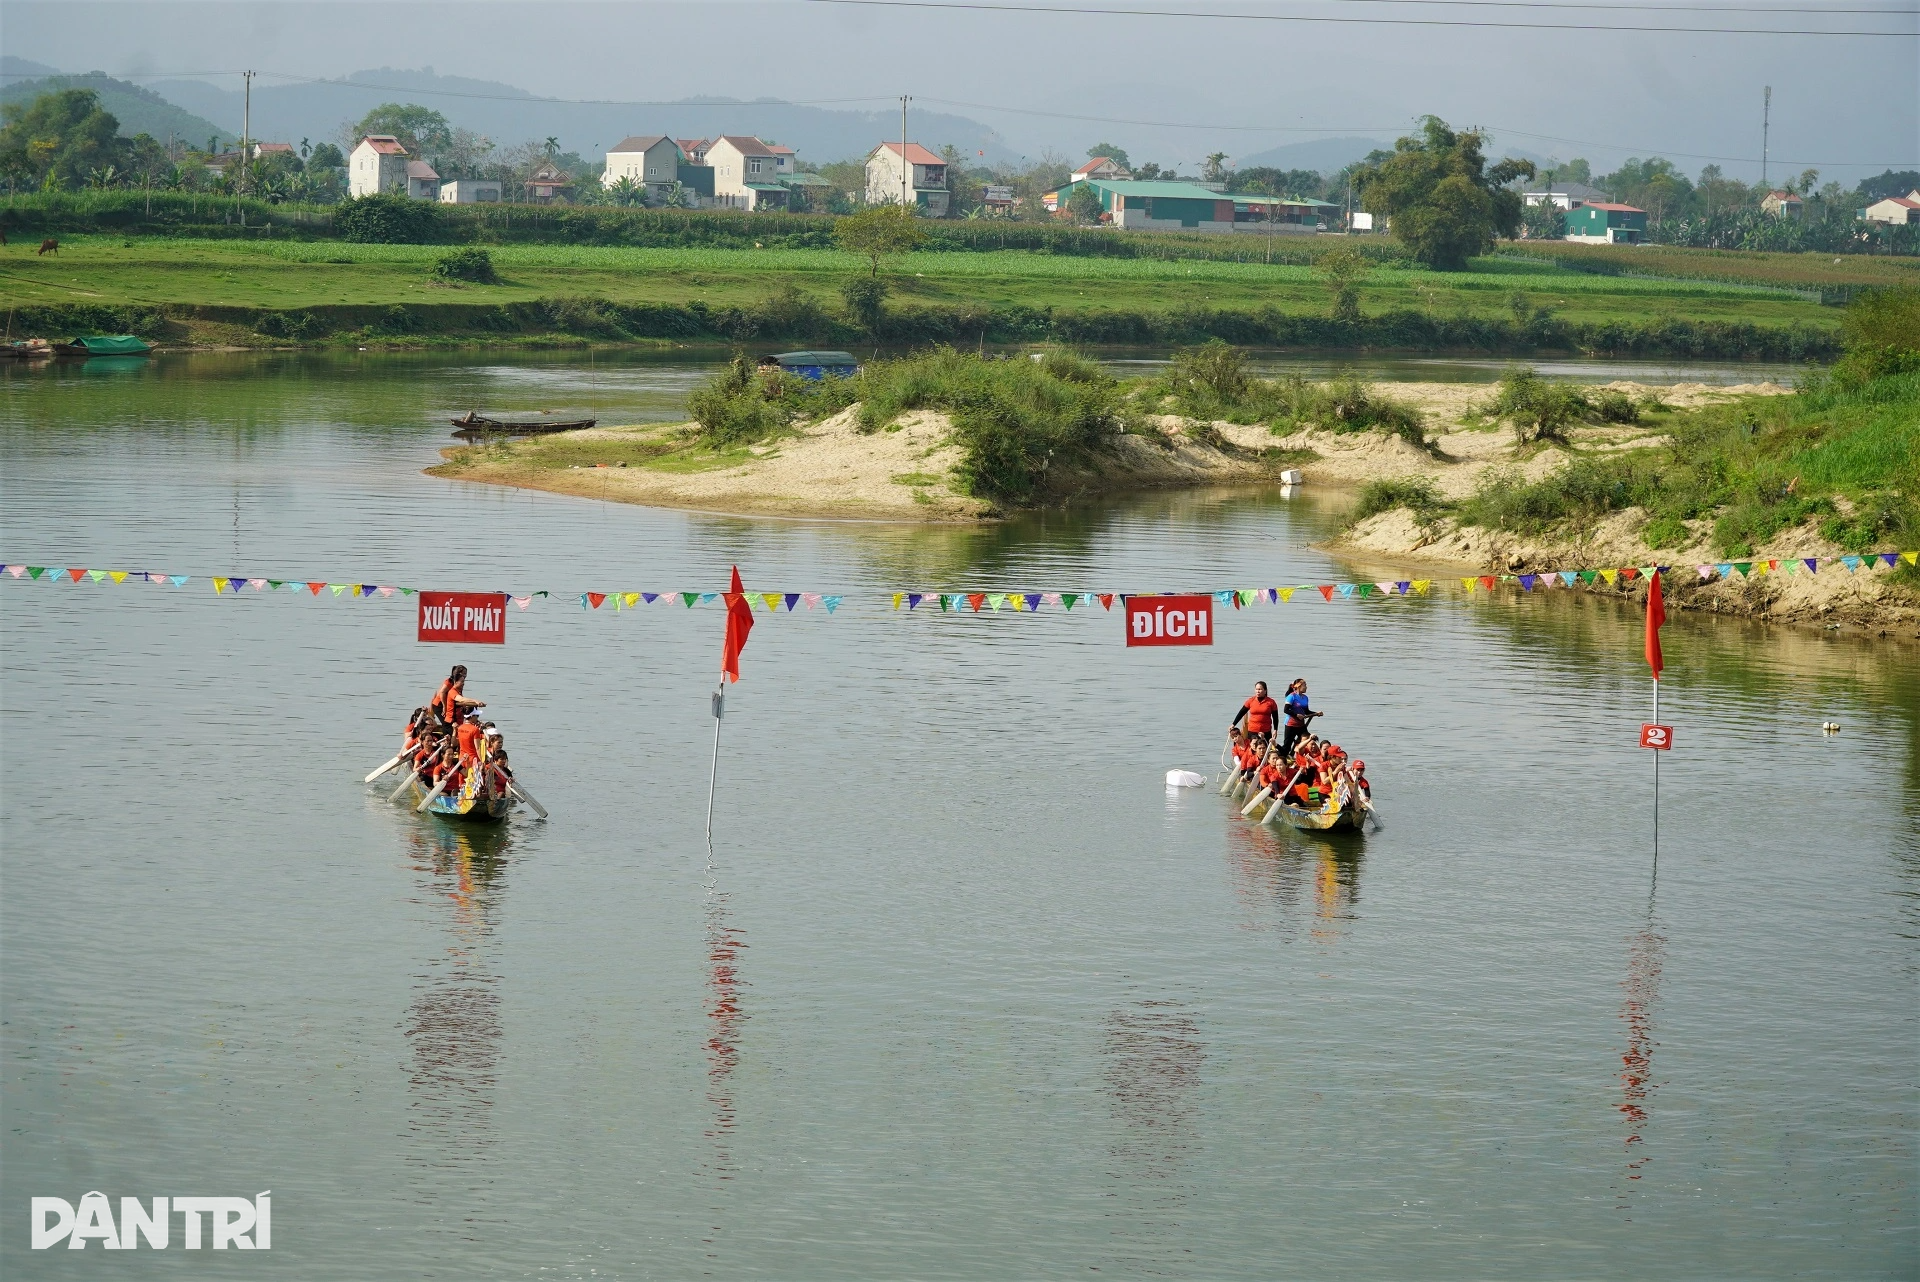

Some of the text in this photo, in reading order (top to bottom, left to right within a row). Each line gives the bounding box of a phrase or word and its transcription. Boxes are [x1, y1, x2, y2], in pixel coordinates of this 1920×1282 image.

[423, 598, 501, 631] XUẤT PHÁT
[1132, 606, 1207, 637] ĐÍCH
[1647, 728, 1666, 745] 2
